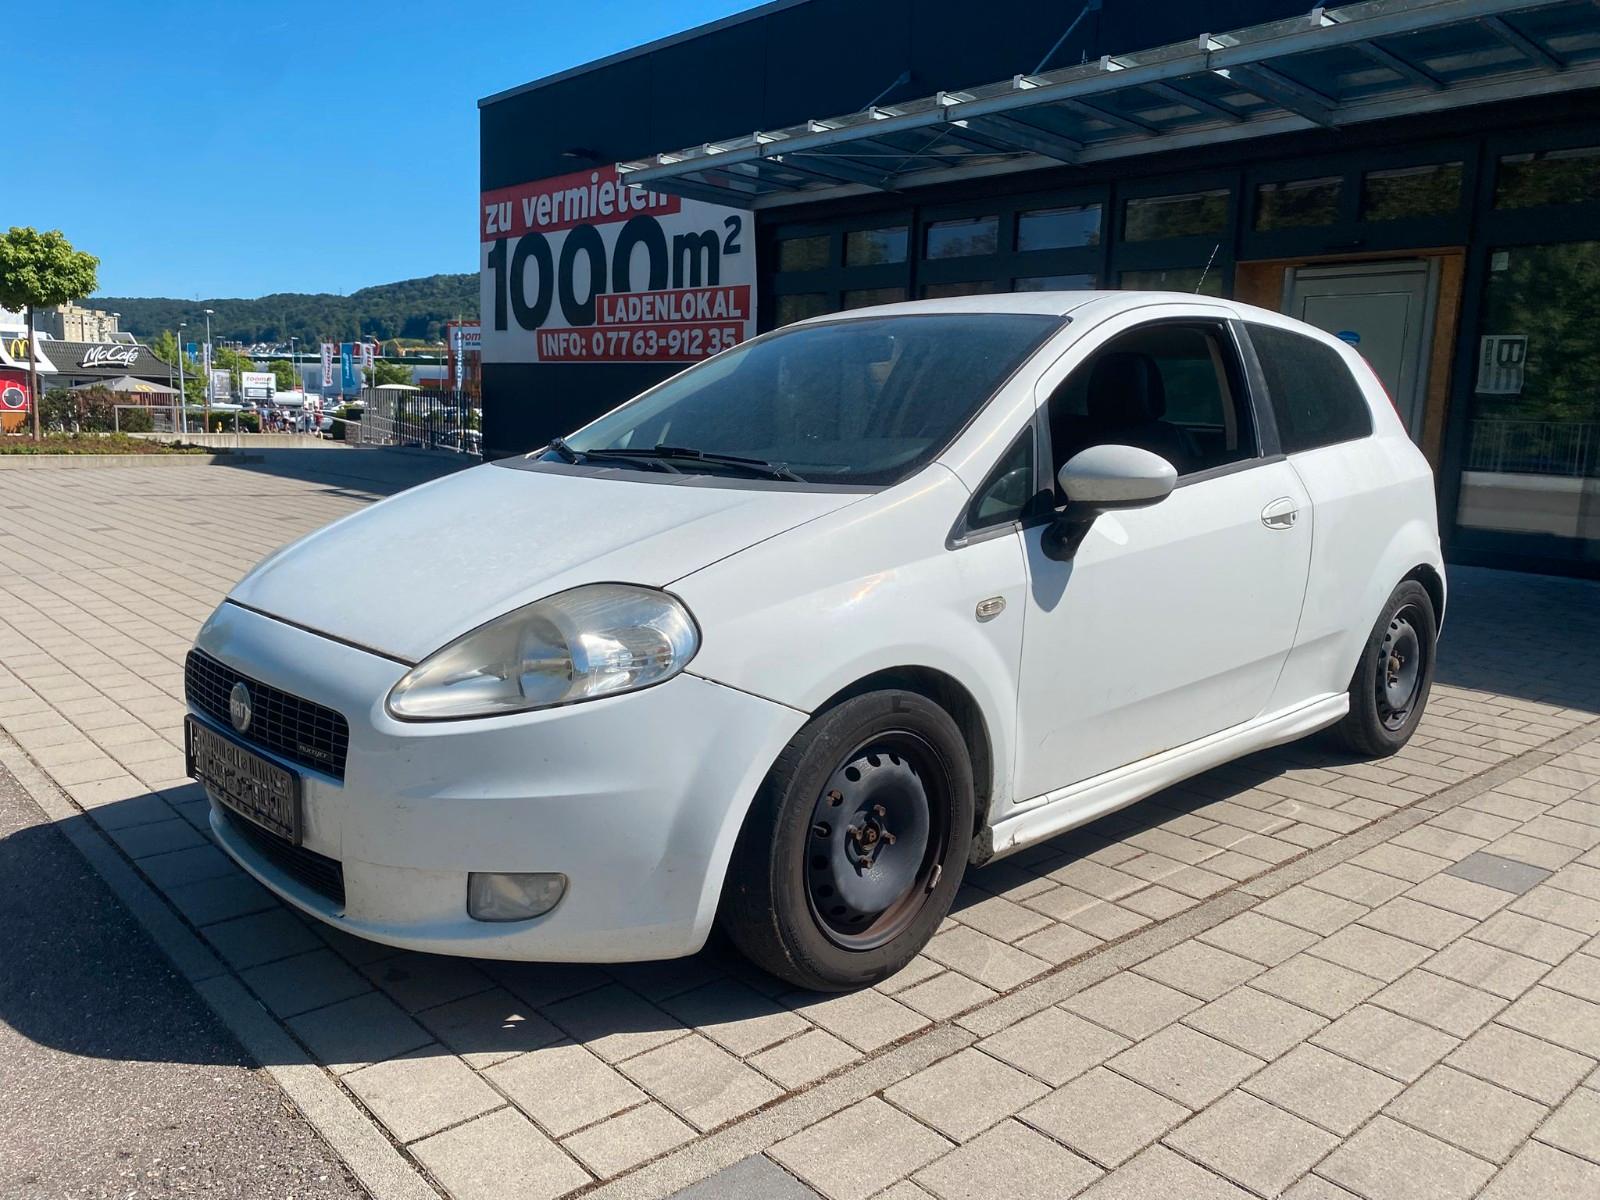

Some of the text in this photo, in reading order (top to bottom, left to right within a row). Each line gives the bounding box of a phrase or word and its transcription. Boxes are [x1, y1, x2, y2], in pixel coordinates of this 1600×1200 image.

[485, 201, 512, 234] zu
[603, 290, 742, 323] LADENLOKAL
[542, 332, 587, 357] INFO:
